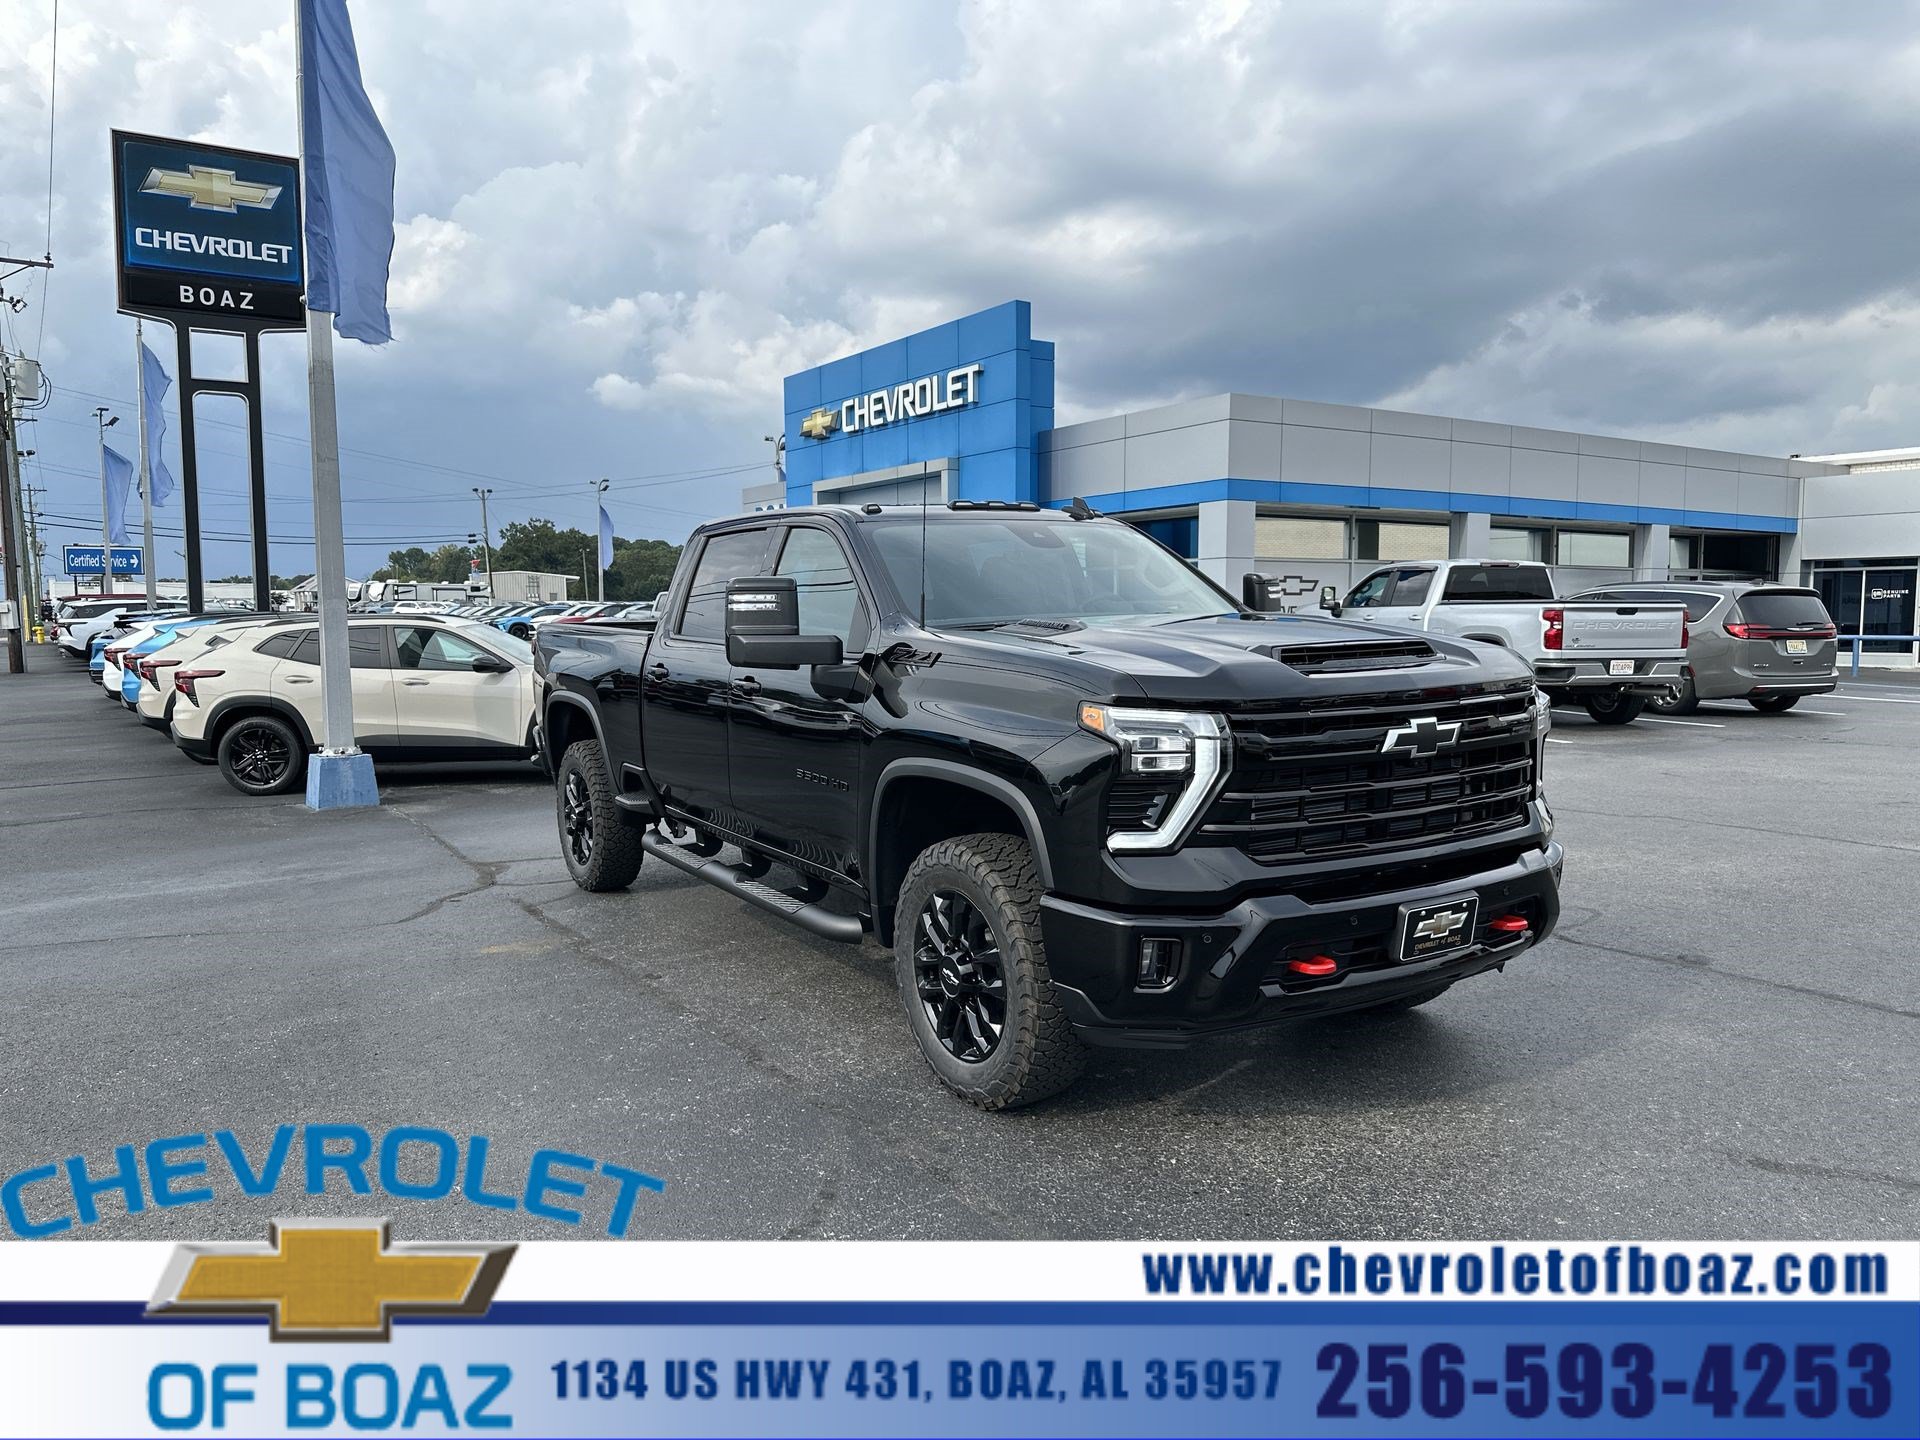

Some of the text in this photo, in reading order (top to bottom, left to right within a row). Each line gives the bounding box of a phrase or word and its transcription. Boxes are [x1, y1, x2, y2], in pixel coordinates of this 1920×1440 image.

[135, 227, 292, 264] CHEVROLET
[179, 285, 254, 310] BOAZ
[841, 363, 982, 433] CHEVROLET
[69, 554, 127, 567] Certified Srvice
[1572, 621, 1678, 630] CHEVROLET
